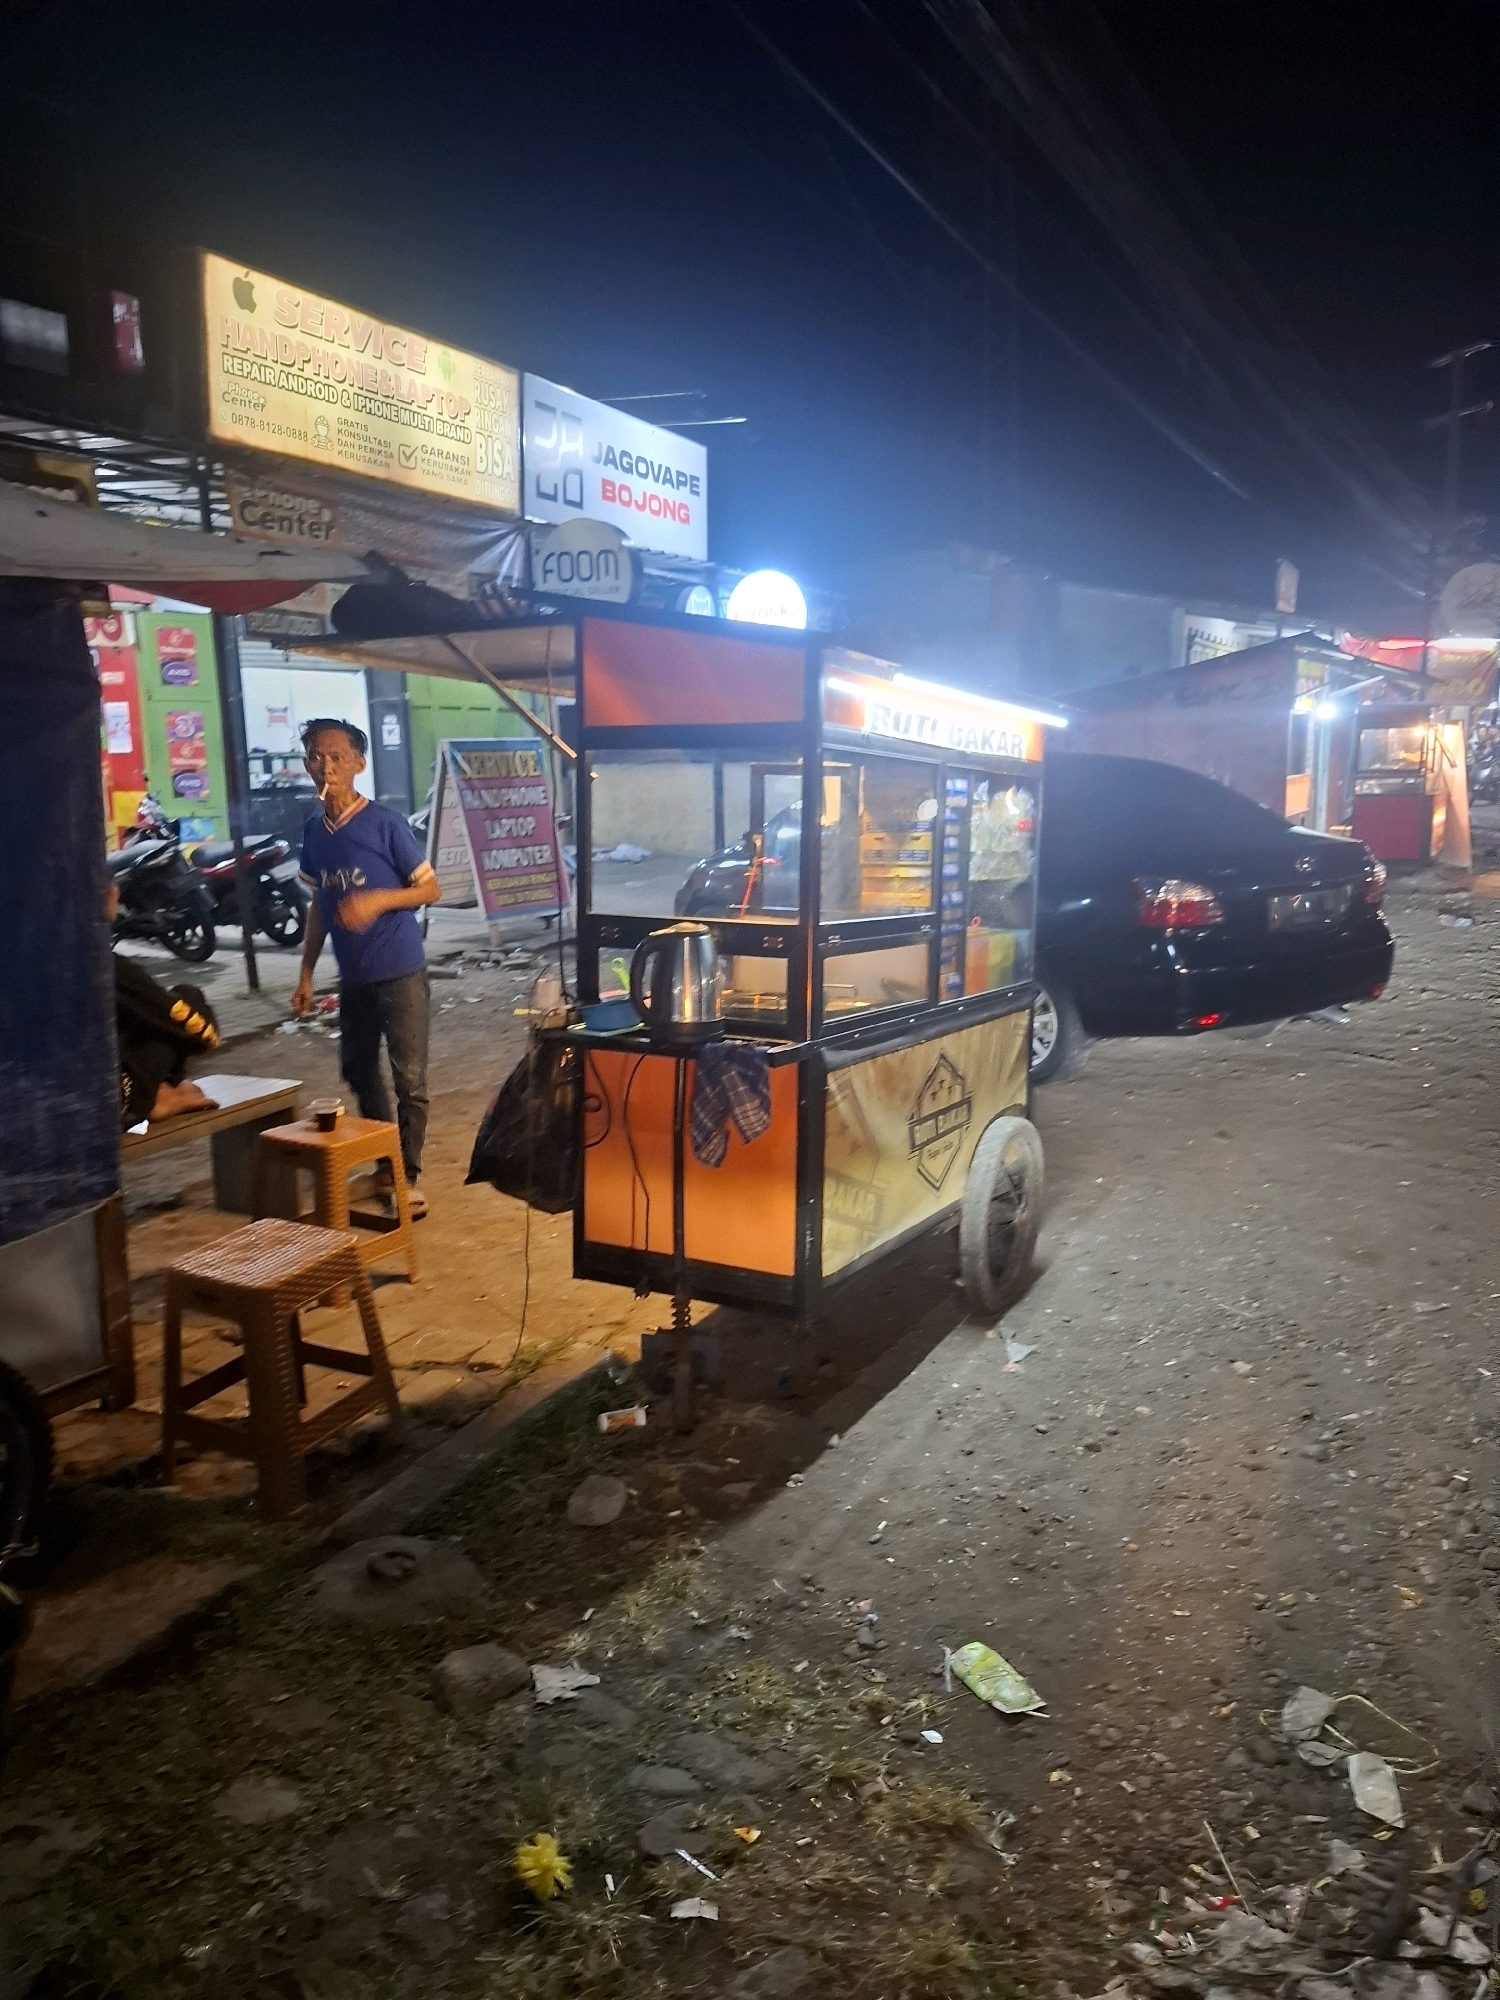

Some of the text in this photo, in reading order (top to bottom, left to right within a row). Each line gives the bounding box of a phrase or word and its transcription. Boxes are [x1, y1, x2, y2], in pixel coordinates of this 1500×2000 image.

[274, 288, 427, 374] SERVICE
[222, 353, 472, 445] REPAIR ANDROID & IPHONE MULTI BRAND
[222, 391, 266, 412] Center
[228, 381, 259, 401] Phone
[474, 378, 510, 415] RUSAK
[337, 417, 369, 432] GRATIS
[474, 406, 510, 439] RINGAN
[337, 427, 391, 449] KONSULTASI
[337, 438, 394, 460] DAN PERIKSA
[337, 450, 391, 470] KERUSAKAN
[421, 444, 470, 467] GARANSI
[421, 457, 471, 476] KERUSAKAN
[475, 432, 515, 482] BISA
[591, 441, 701, 498] JAGOVAPE
[421, 467, 469, 486] YANG SAMA
[475, 478, 515, 505] DITUNGGU
[601, 477, 690, 525] BOJONG
[238, 498, 336, 541] Center
[870, 702, 1023, 760] ROTI BAKAR
[459, 750, 541, 780] SERVICE
[484, 815, 536, 840] LAPTOP
[480, 843, 555, 872] KOMPUTER
